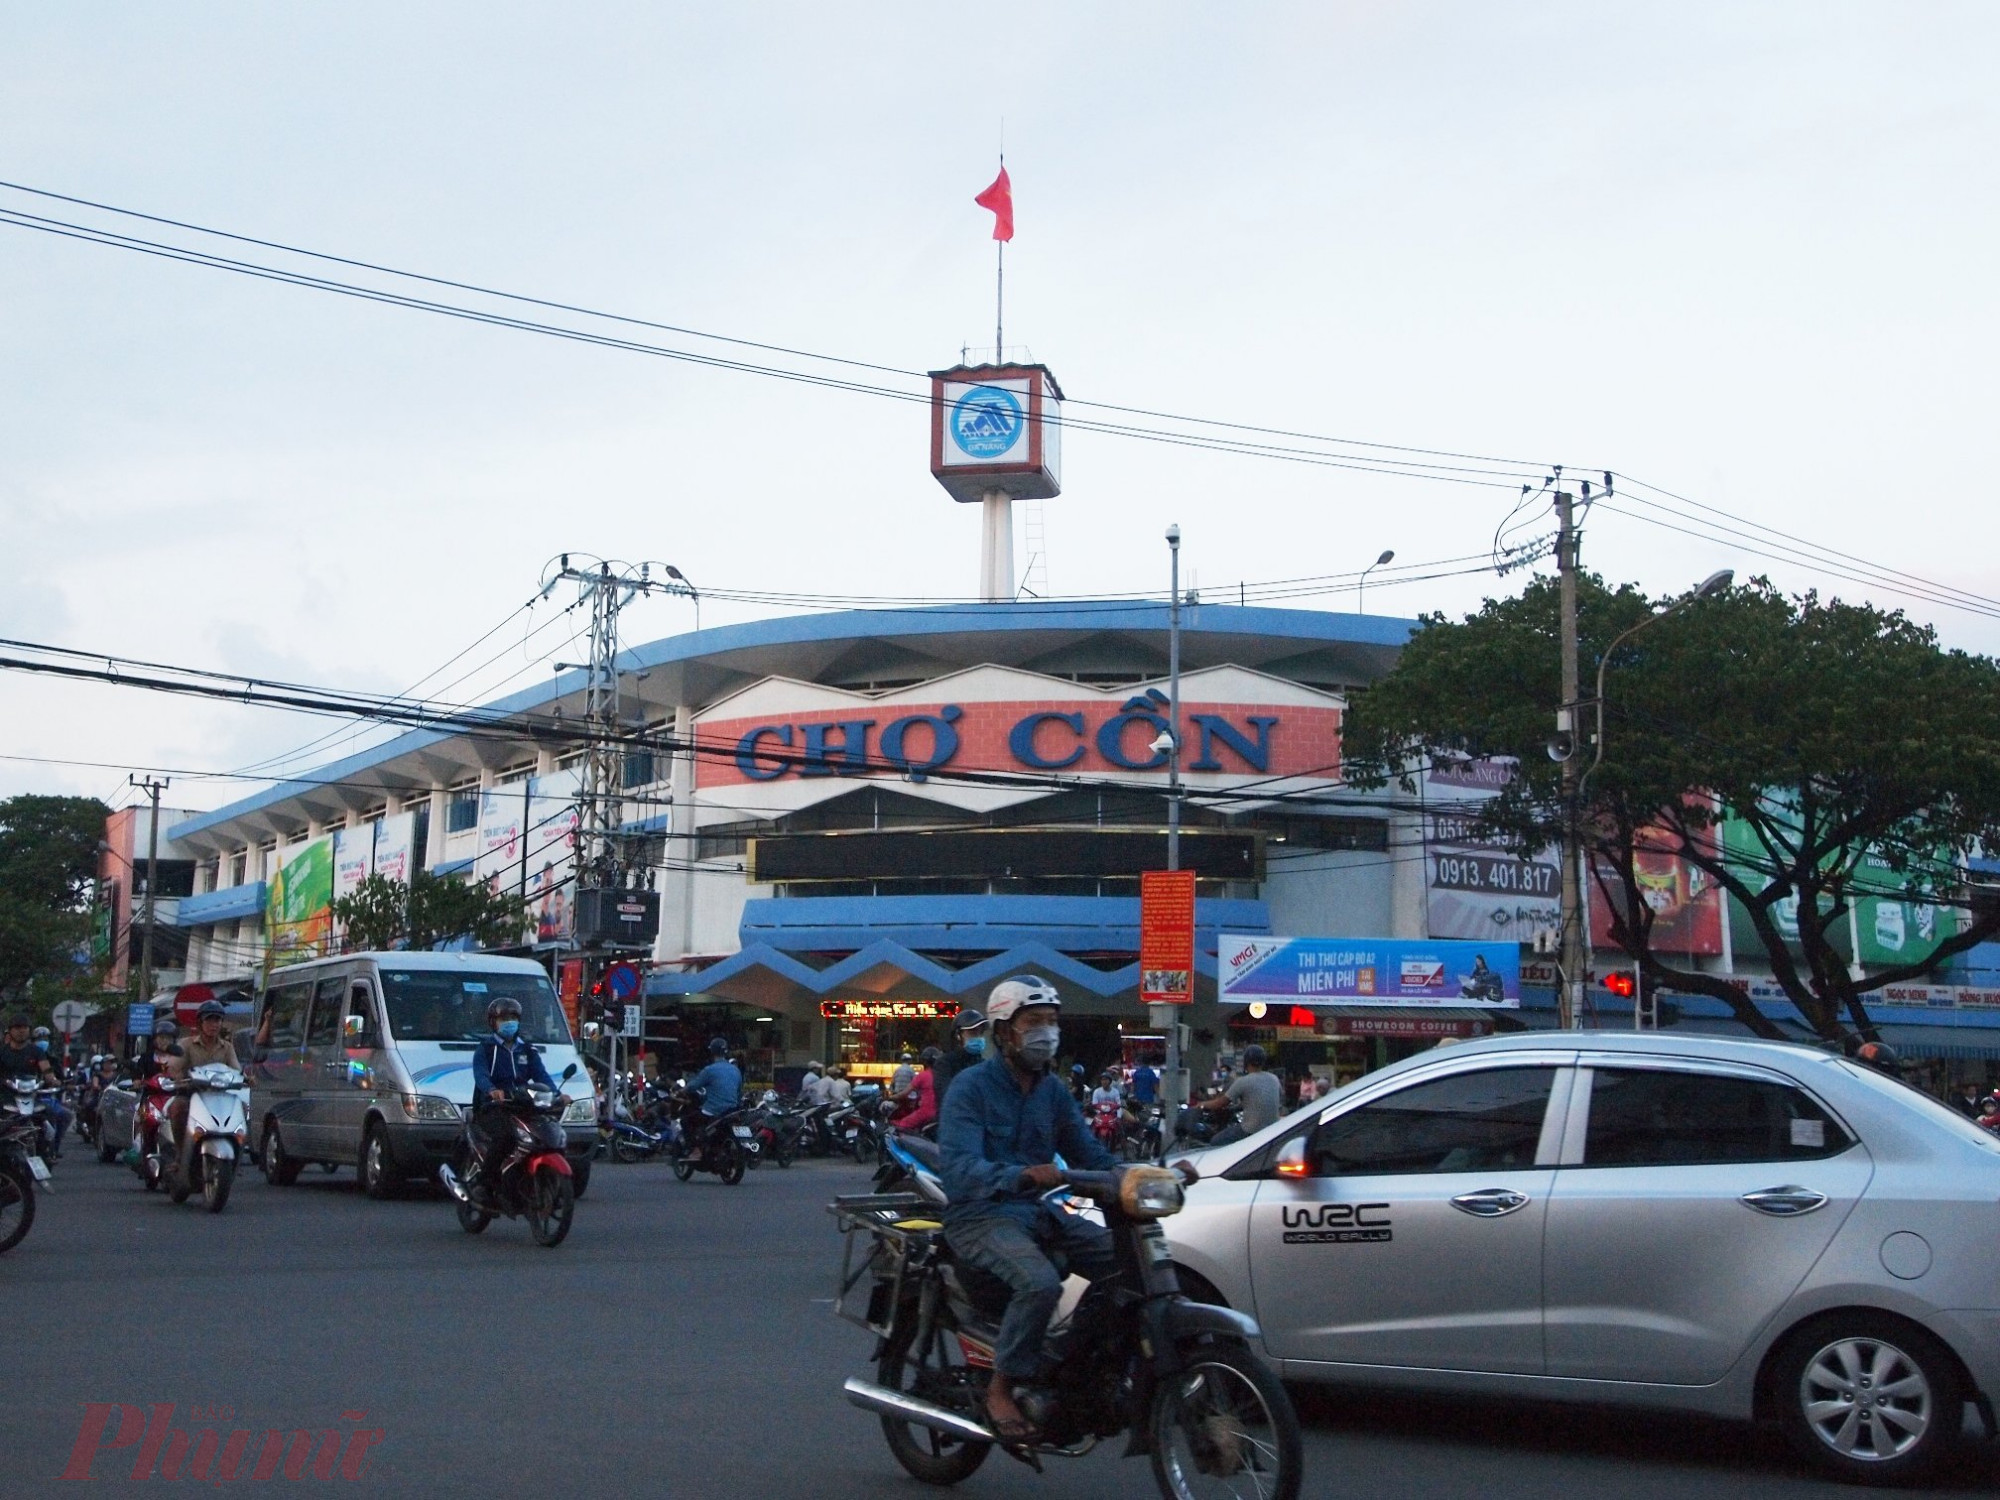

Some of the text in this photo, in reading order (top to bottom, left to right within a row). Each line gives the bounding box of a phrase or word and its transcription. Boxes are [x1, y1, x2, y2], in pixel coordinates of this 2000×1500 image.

[735, 688, 1279, 783] CHỢ CỒN
[1440, 858, 1552, 893] 0913. 401.817
[1298, 952, 1316, 967] THI
[893, 1003, 916, 1015] Kim
[1352, 1021, 1458, 1032] SHOWROOM COFFEE
[1283, 1203, 1391, 1228] WRC
